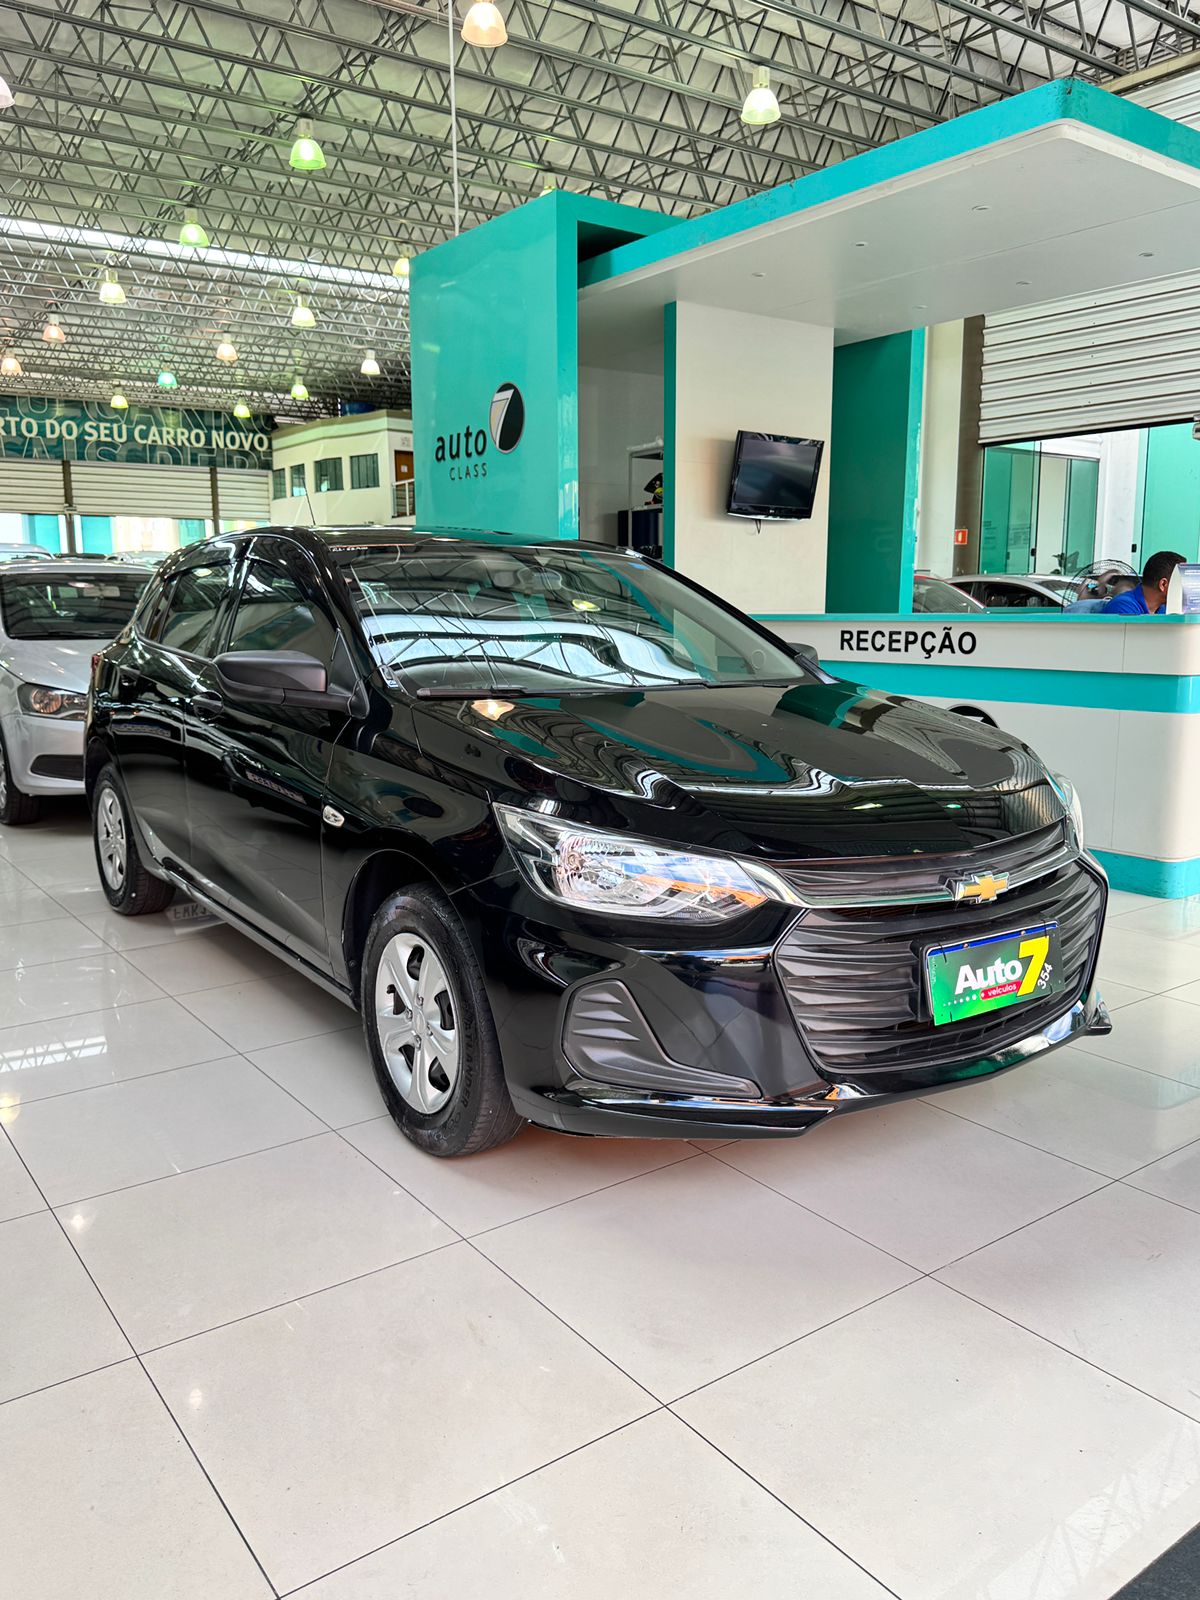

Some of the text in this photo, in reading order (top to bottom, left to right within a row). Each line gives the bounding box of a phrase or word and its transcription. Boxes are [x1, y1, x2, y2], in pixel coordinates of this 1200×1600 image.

[45, 419, 78, 440] DO
[84, 421, 128, 443] SEU
[134, 424, 206, 448] CARRO
[211, 430, 269, 451] NOVO
[435, 425, 487, 463] auto
[449, 462, 488, 481] CLASS
[840, 626, 977, 659] RECEPÇÃO
[955, 957, 1023, 995] Auto
[1017, 935, 1049, 997] 7
[1037, 962, 1053, 990] 354
